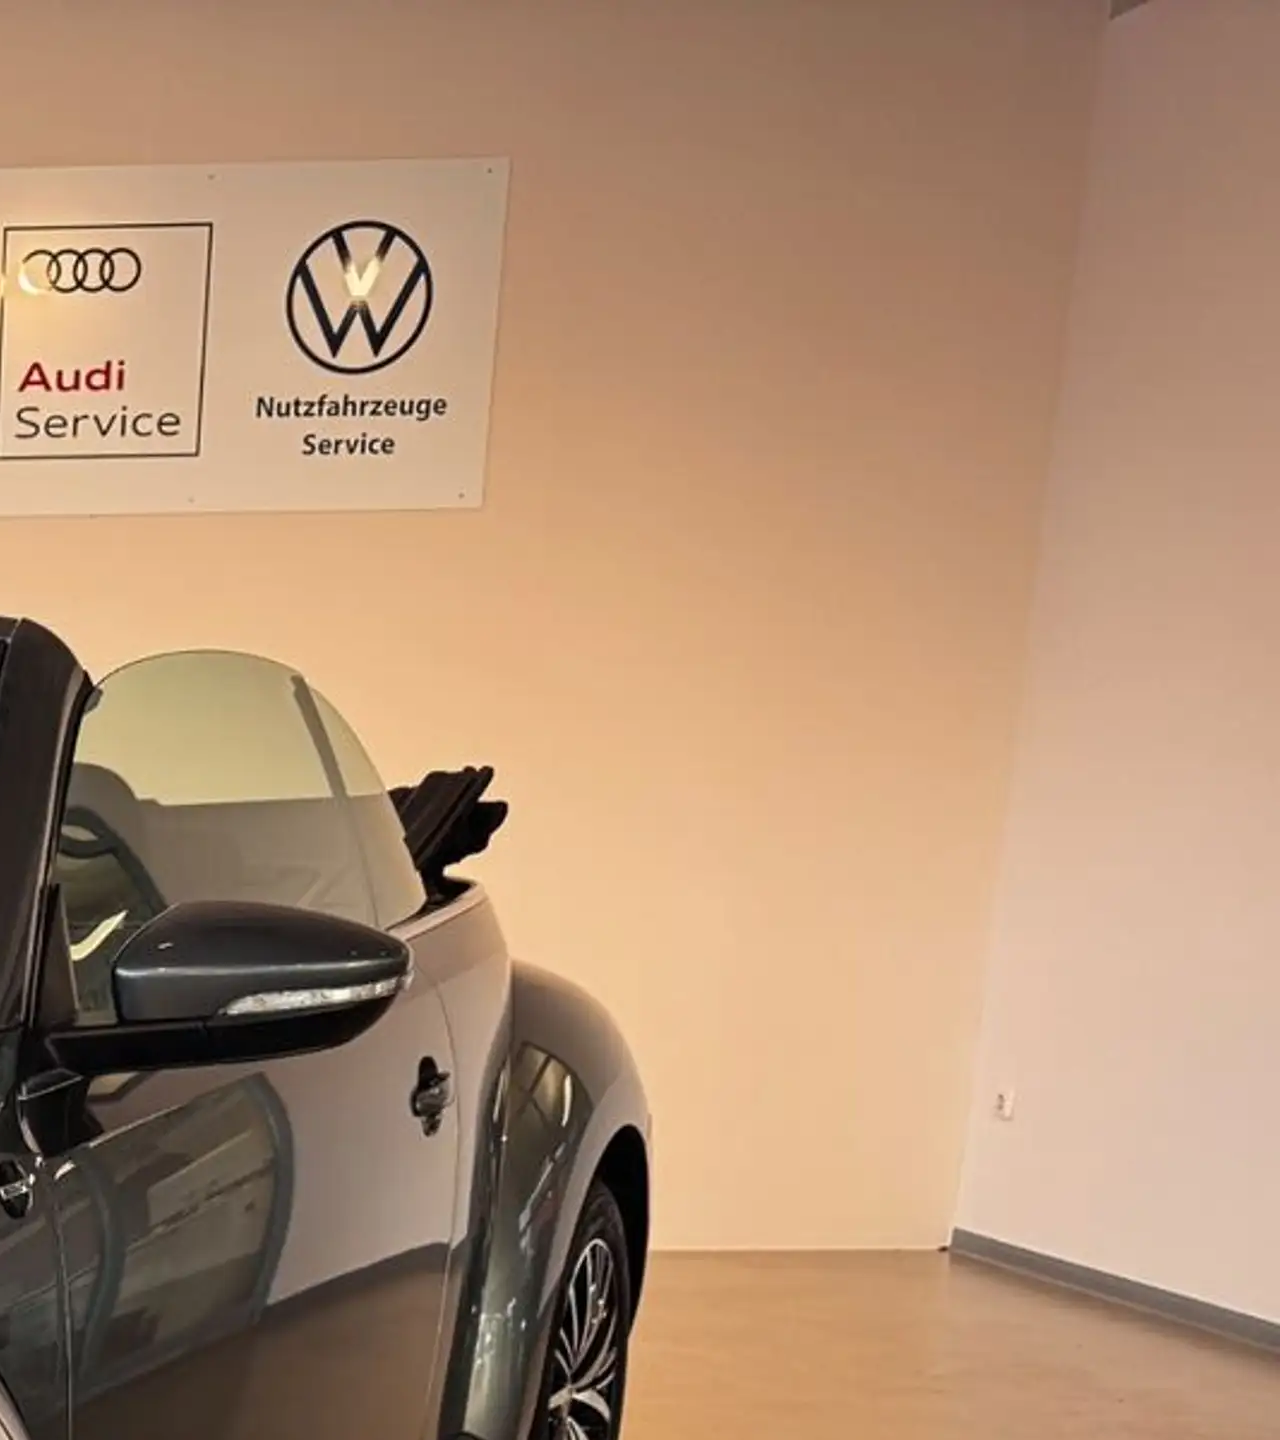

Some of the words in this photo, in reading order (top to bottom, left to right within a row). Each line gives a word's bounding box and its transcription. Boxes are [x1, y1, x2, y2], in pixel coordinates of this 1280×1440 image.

[17, 359, 126, 393] Audi
[254, 394, 448, 421] Nutzfahrzeuge
[13, 406, 182, 440] Service
[301, 433, 396, 458] Service
